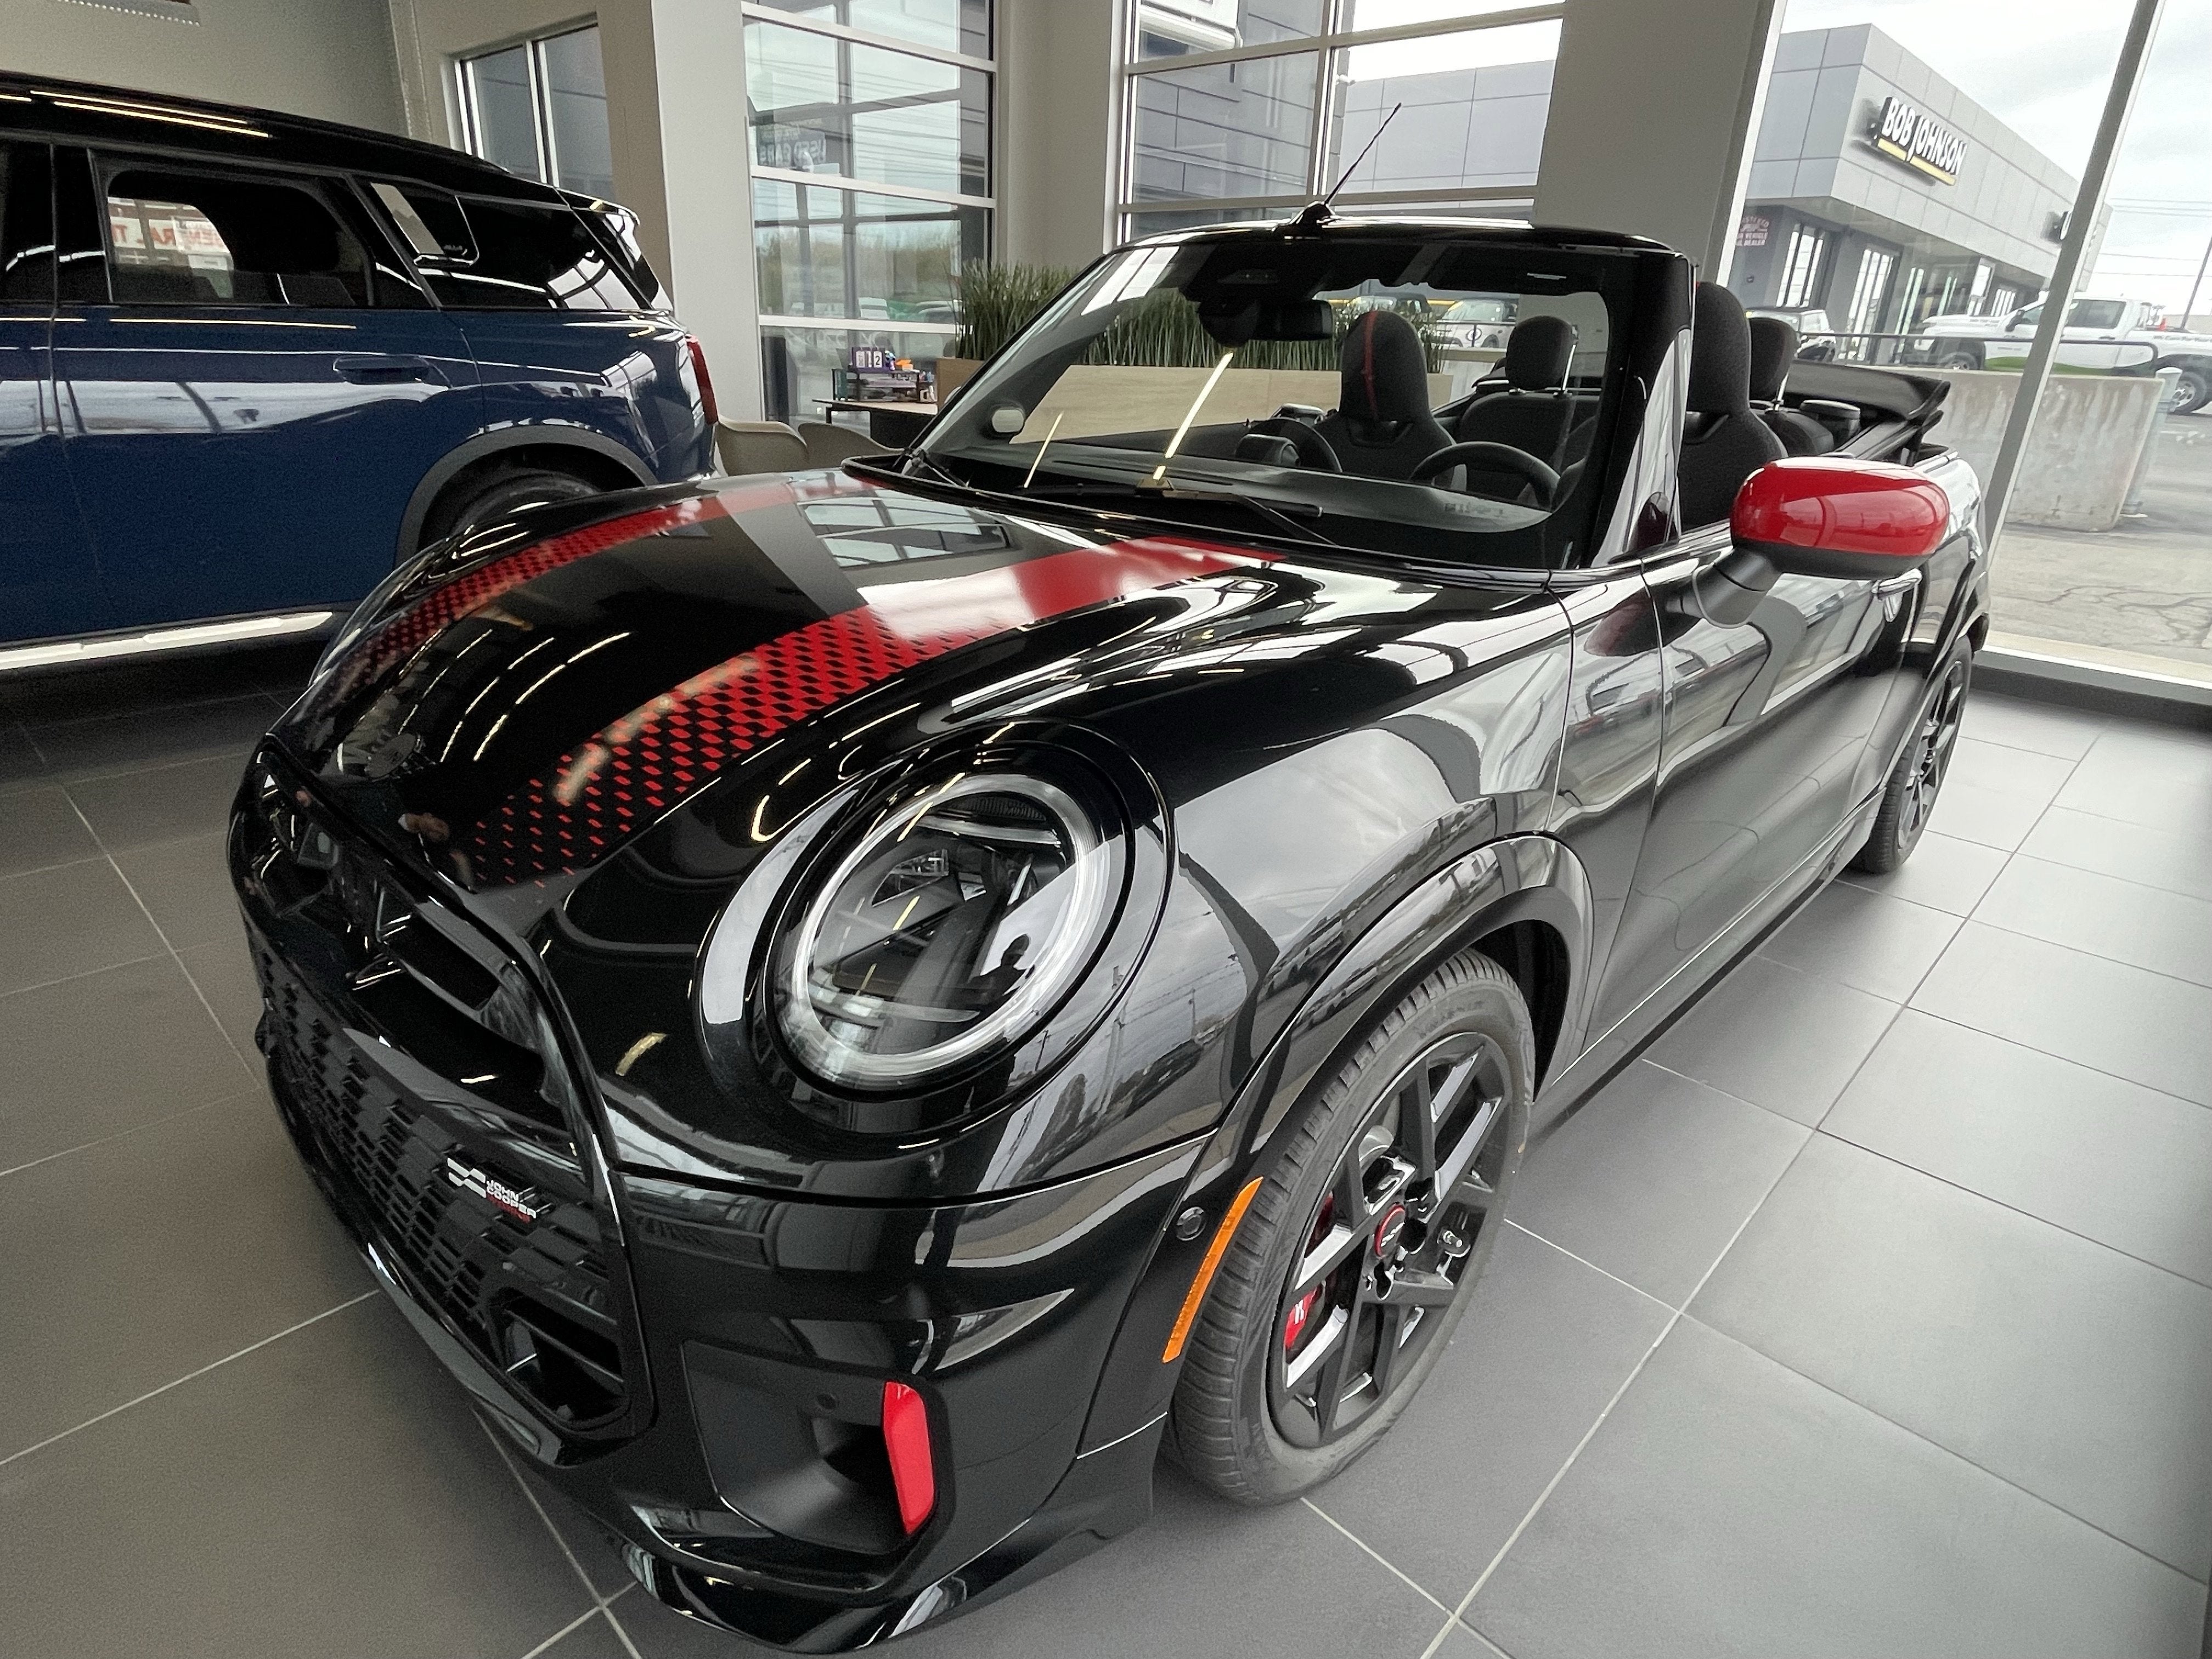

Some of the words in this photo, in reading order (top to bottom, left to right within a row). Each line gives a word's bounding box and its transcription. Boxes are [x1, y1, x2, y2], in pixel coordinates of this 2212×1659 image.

[1881, 97, 1916, 146] BOB
[1906, 115, 1968, 176] JOHNSON
[486, 1180, 519, 1201] JOHN
[486, 1186, 537, 1218] COOPER
